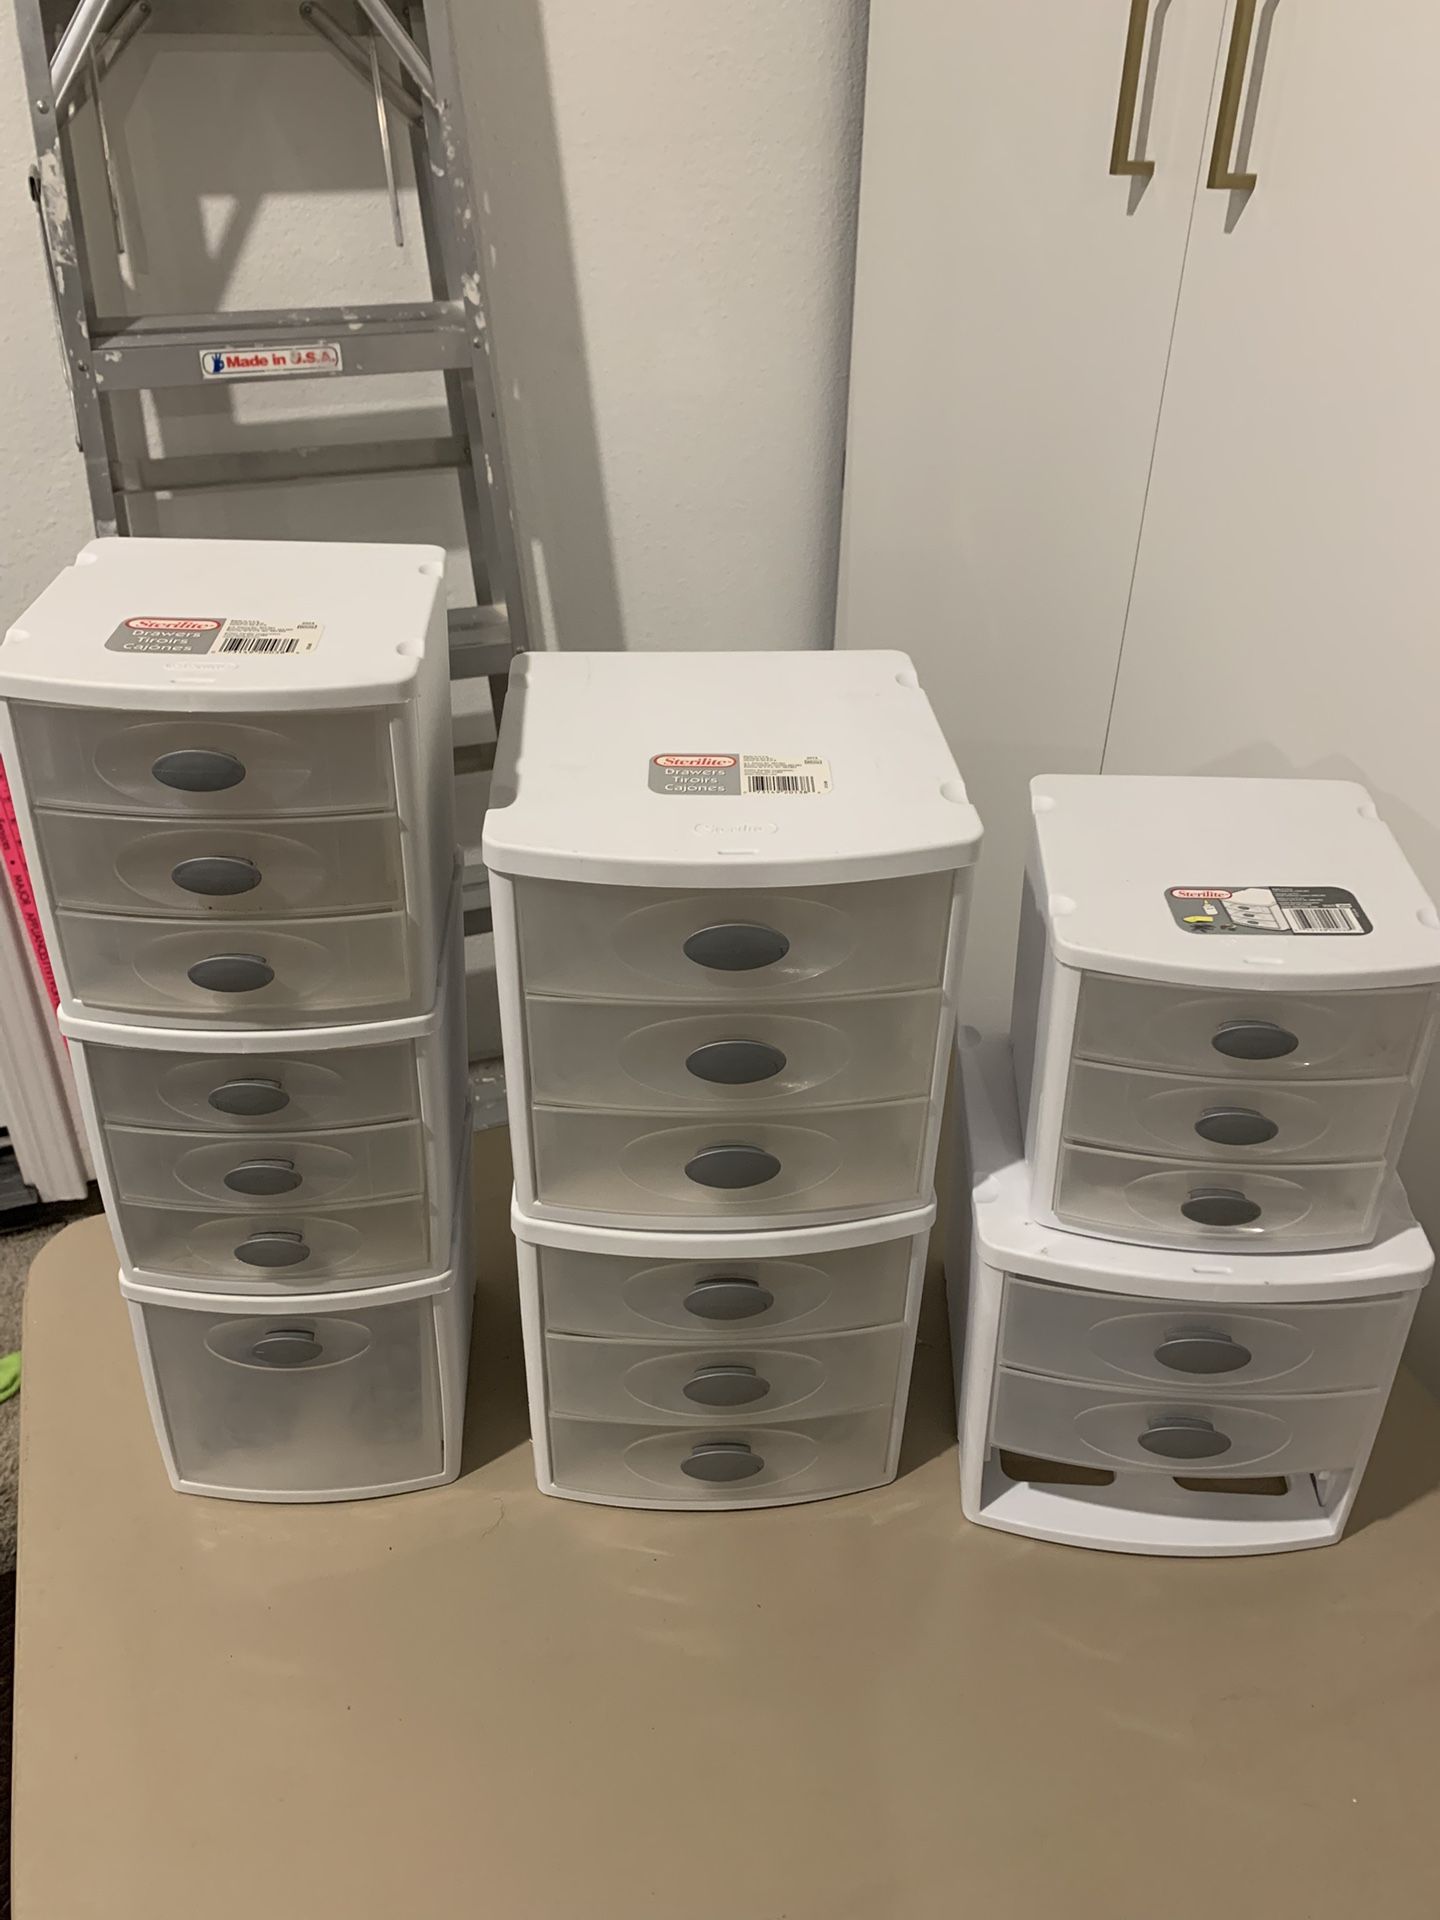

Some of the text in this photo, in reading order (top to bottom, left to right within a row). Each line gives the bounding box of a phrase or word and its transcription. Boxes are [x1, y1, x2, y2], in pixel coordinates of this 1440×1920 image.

[226, 351, 336, 368] Made in U.S.A.
[135, 620, 210, 629] Sterilite
[132, 630, 202, 638] Drawers
[137, 636, 189, 645] Tiroirs
[123, 643, 193, 652] Cajones
[663, 757, 727, 766] Sterilite
[664, 768, 726, 776] Drawers
[672, 775, 719, 784] Tiroirs
[664, 784, 726, 793] Cajones
[1178, 890, 1225, 898] Sterilite
